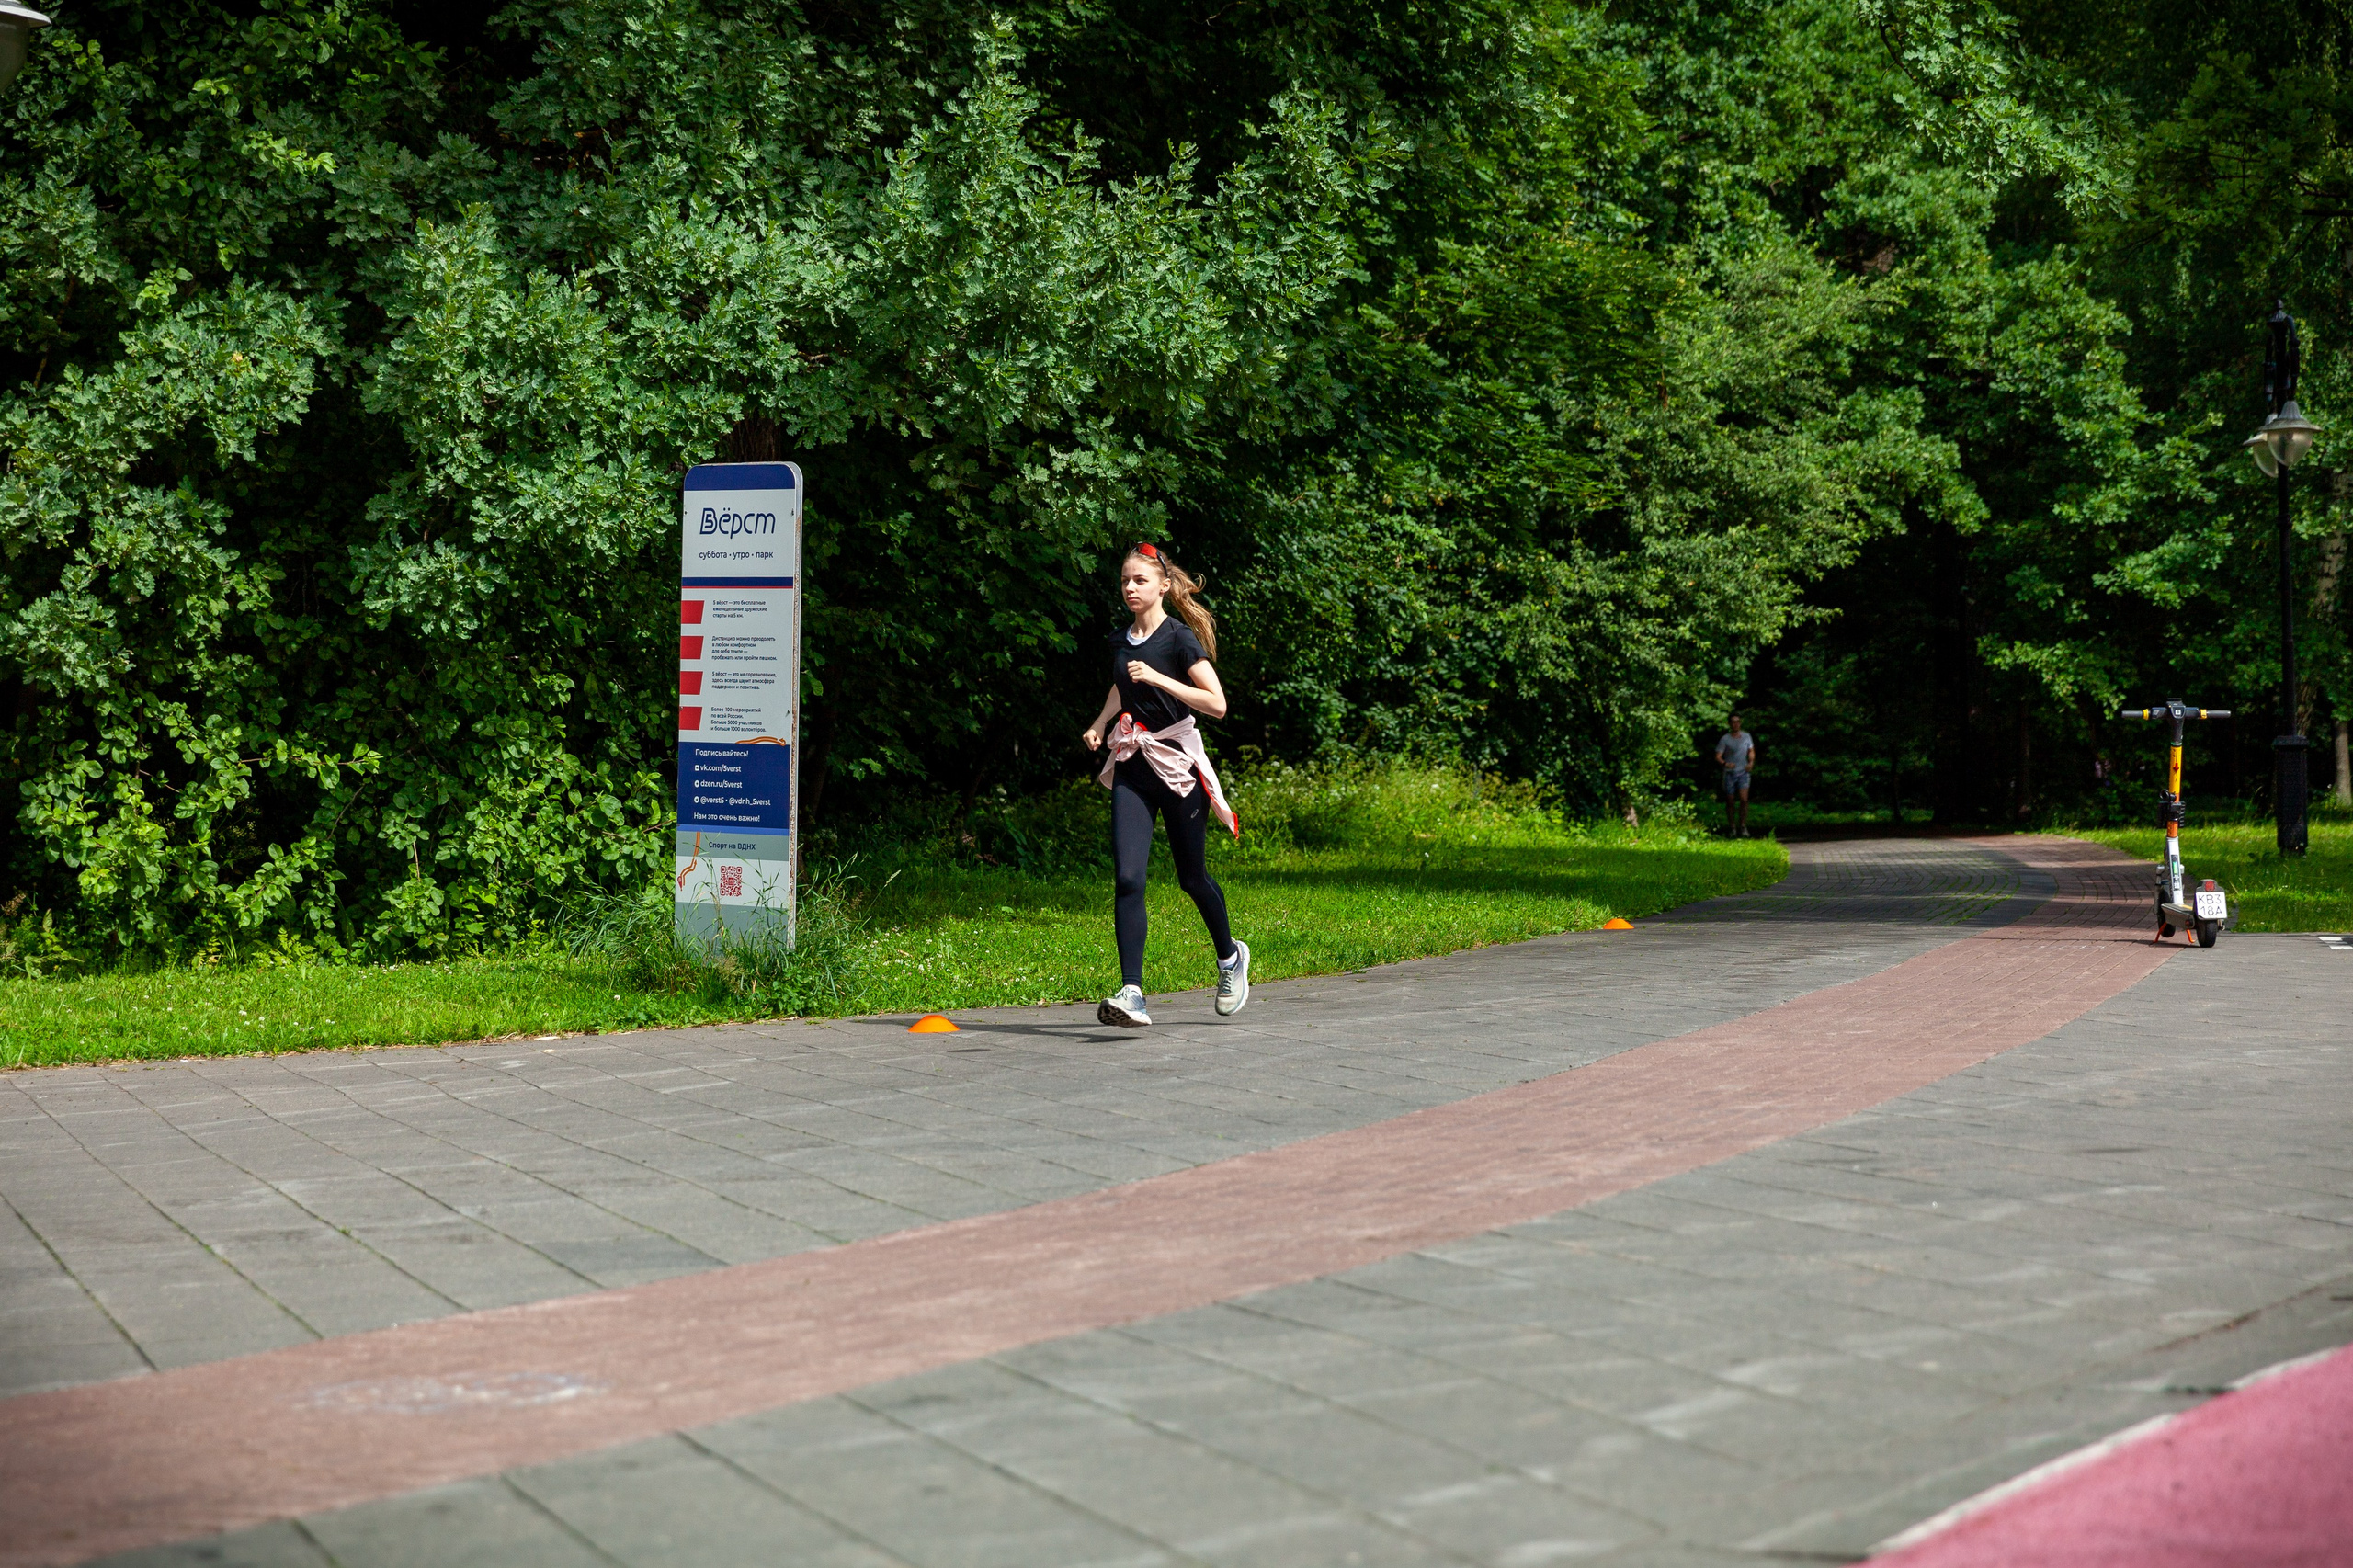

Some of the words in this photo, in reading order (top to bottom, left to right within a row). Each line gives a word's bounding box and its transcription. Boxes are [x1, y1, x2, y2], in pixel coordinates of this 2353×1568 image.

[699, 550, 727, 560] суббота
[695, 749, 749, 757] Подписывайтесь!
[700, 764, 741, 772] vk.com/5verst
[700, 779, 742, 788] dzen.ru/5verst
[700, 796, 724, 805] @verst5
[729, 797, 771, 806] @vdnh_5verst
